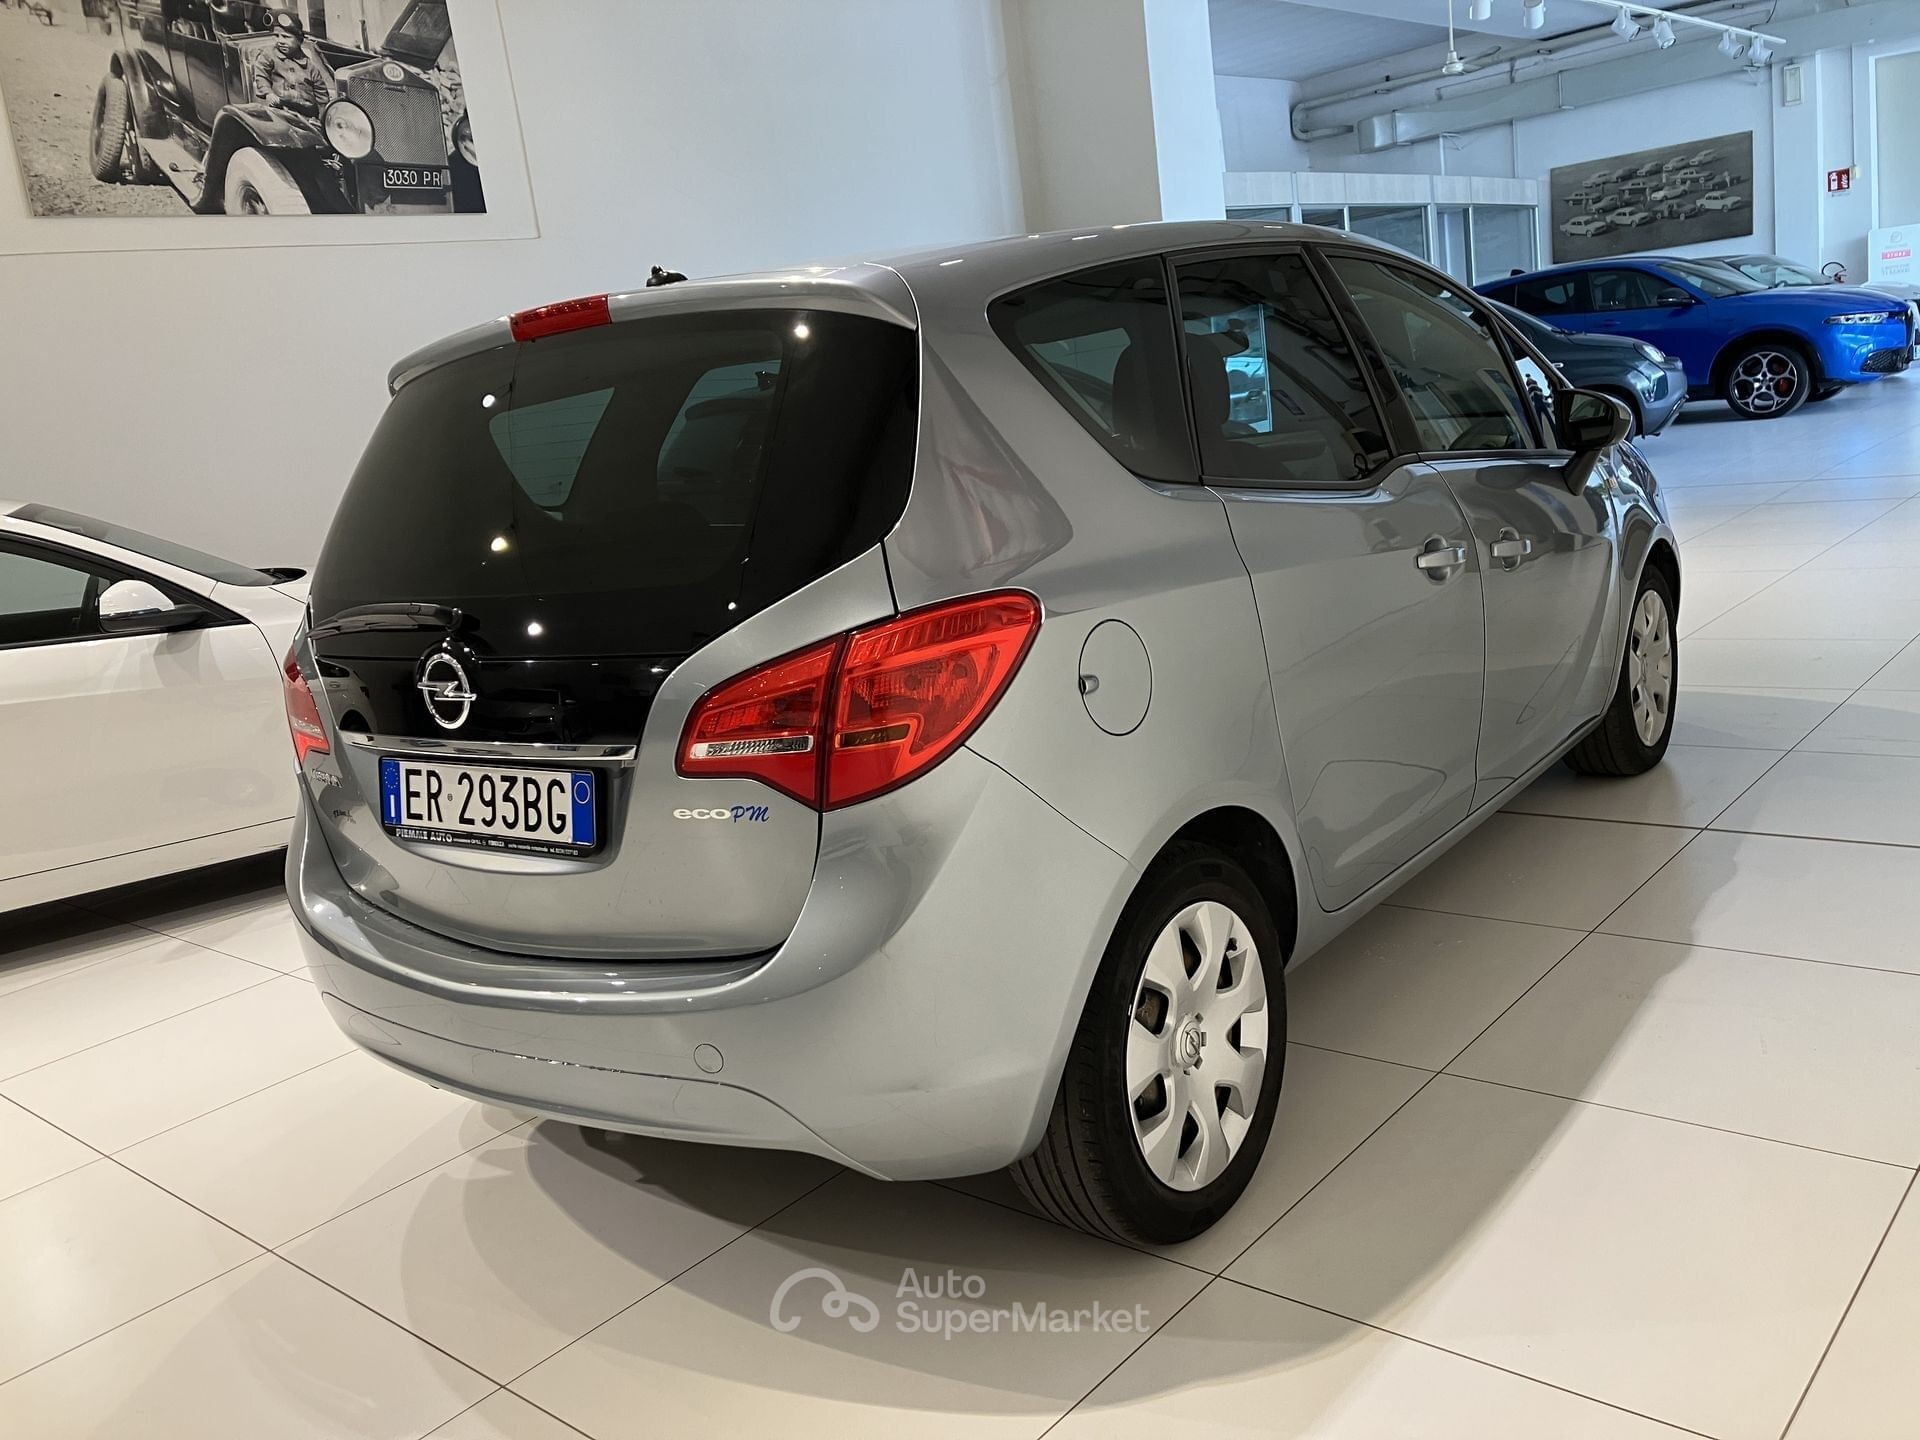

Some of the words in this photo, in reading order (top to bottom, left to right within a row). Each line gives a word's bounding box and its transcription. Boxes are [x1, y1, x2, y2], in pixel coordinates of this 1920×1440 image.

[386, 169, 418, 185] 3030
[423, 171, 441, 186] PR
[405, 768, 443, 823] ER
[457, 771, 567, 835] 293BG
[430, 832, 453, 843] AUTO
